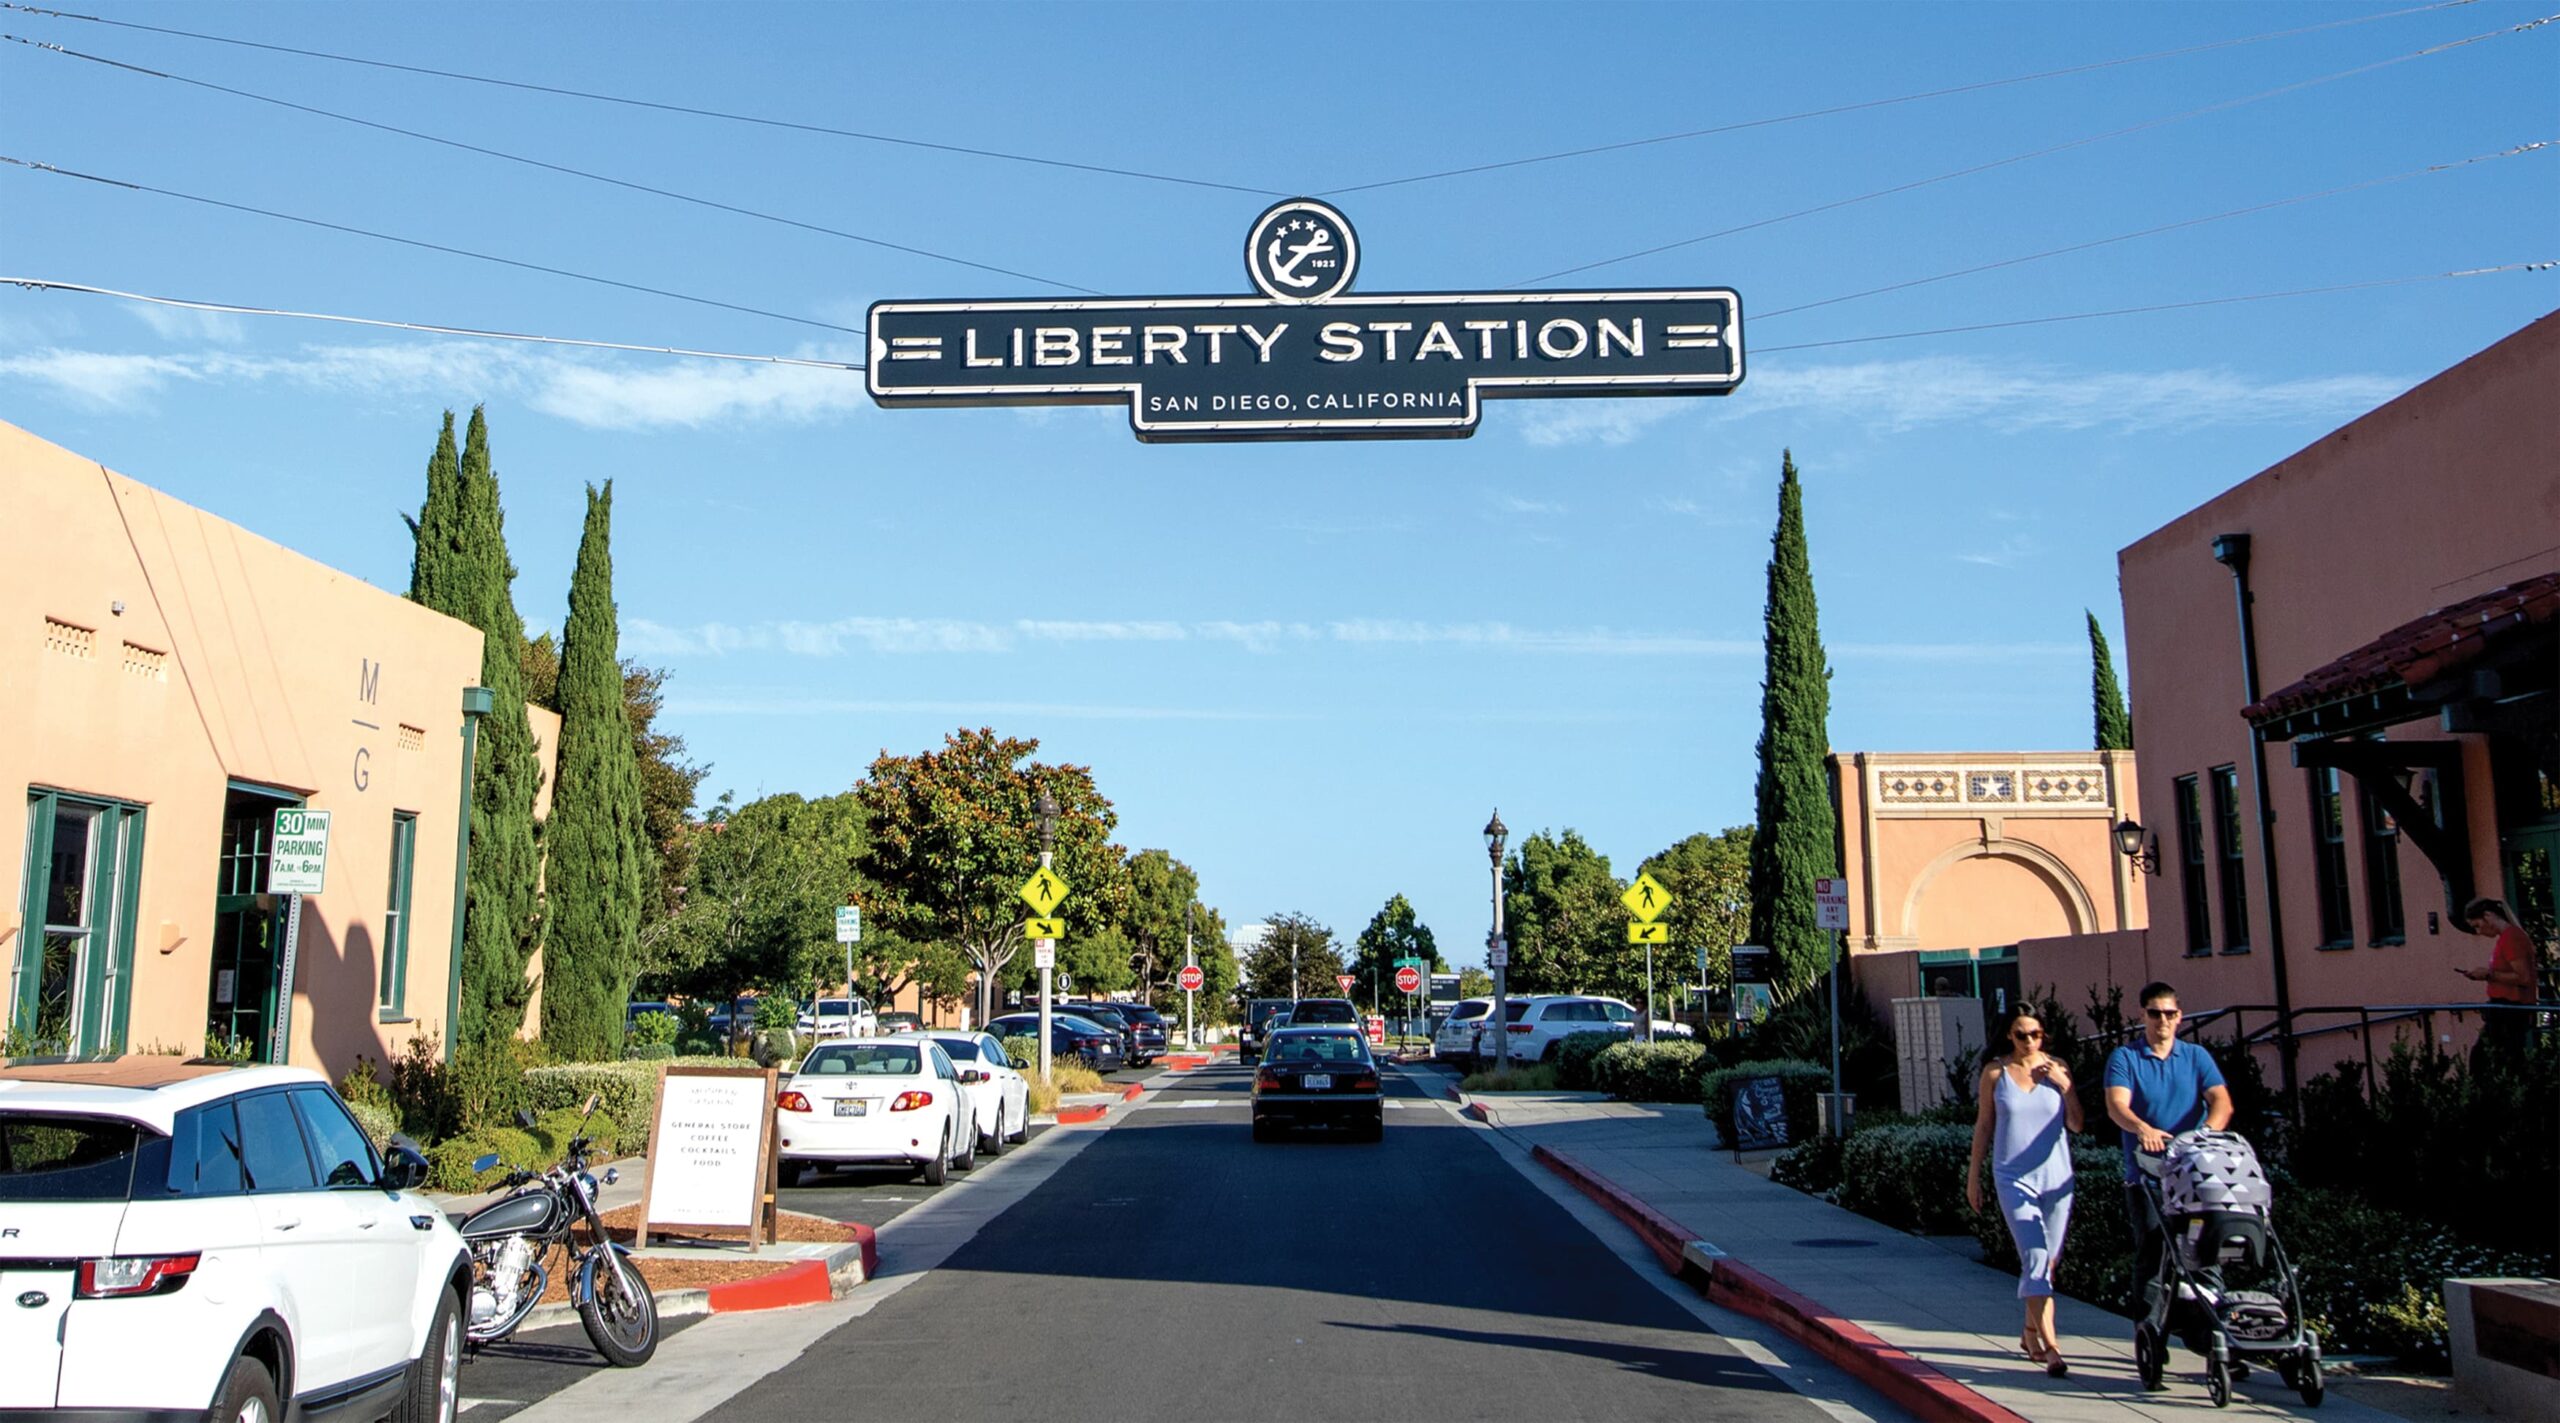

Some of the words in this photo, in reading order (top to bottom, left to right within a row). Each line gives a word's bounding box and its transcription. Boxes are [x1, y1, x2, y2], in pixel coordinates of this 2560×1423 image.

[1312, 260, 1335, 268] 1923
[966, 323, 1289, 367] LIBERTY
[1319, 317, 1645, 362] STATION
[1150, 396, 1199, 411] SAN
[1212, 394, 1298, 412] DIEGO,
[1306, 391, 1463, 409] CALIFORNIA
[360, 658, 379, 705] M
[354, 747, 370, 792] G
[279, 813, 303, 834] 30
[306, 817, 327, 831] MIN
[277, 840, 323, 856] PARKING
[1817, 880, 1829, 892] NO
[1181, 973, 1201, 983] STOP
[1398, 975, 1418, 985] STOP
[690, 1134, 729, 1142] COFFEE
[680, 1146, 737, 1154] COCKTAILS
[693, 1159, 722, 1167] FOOD
